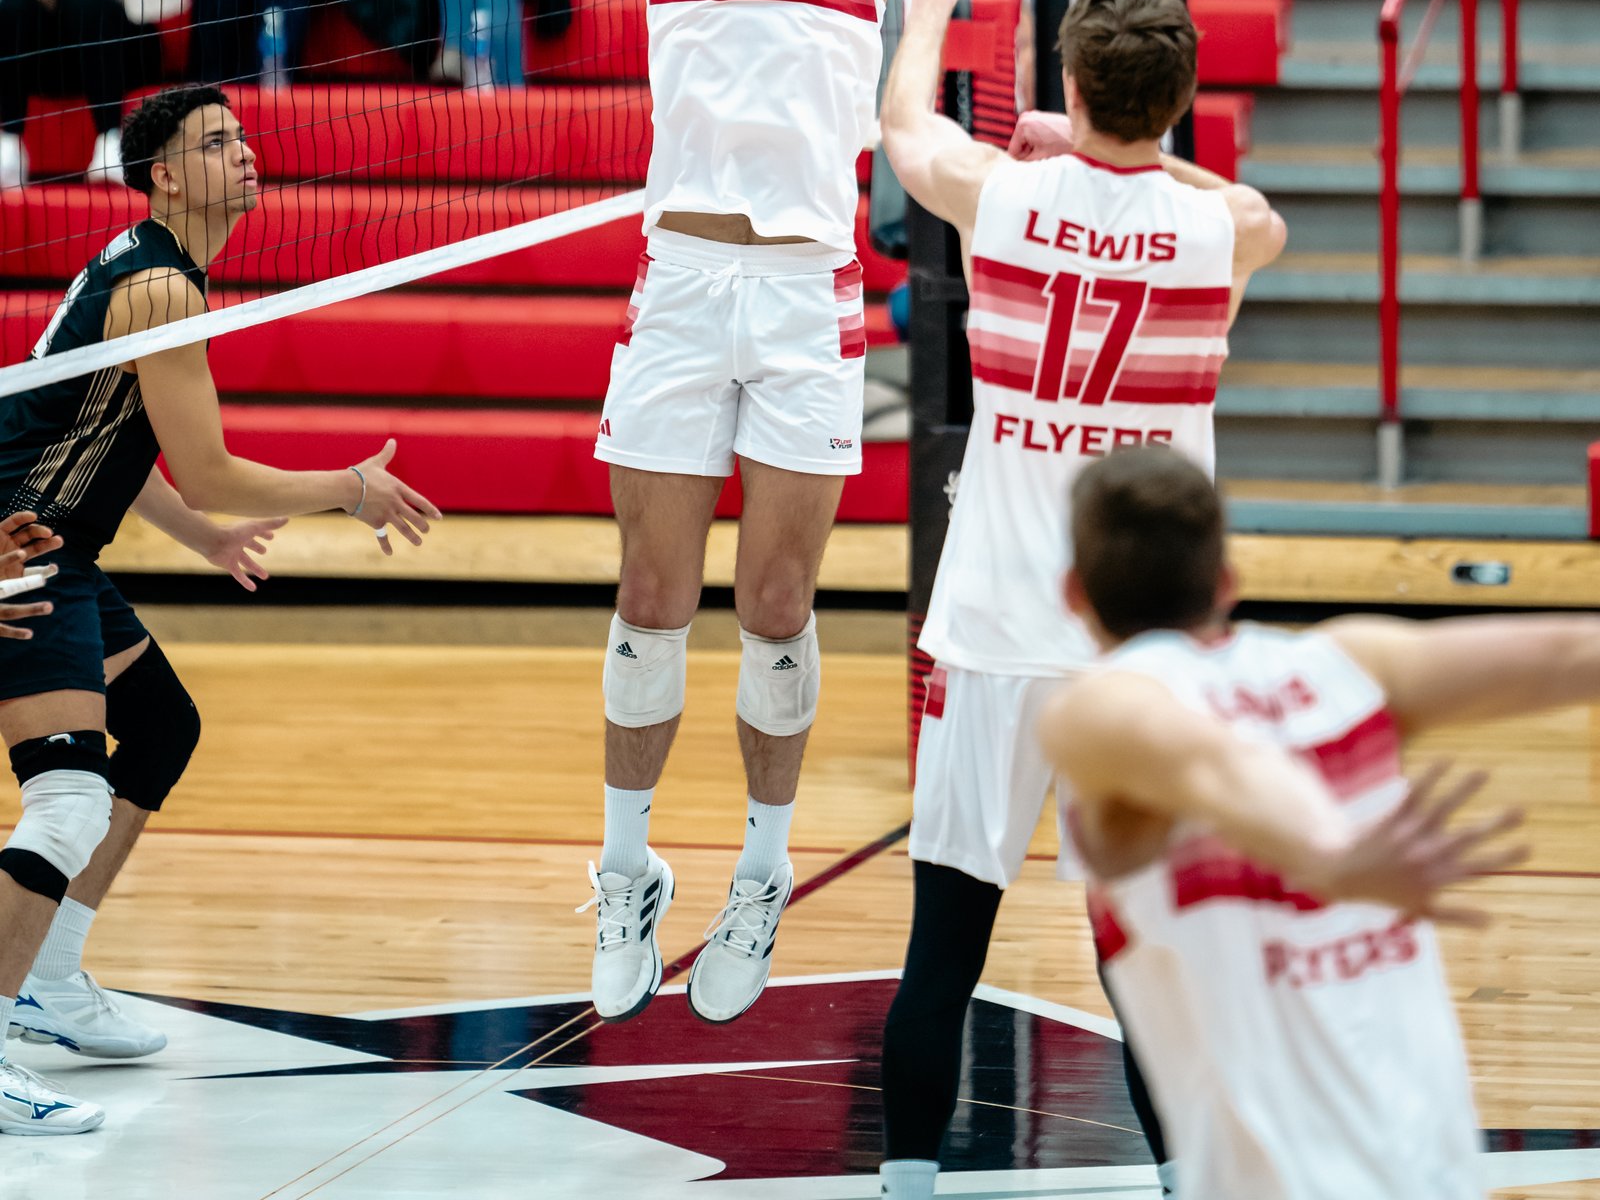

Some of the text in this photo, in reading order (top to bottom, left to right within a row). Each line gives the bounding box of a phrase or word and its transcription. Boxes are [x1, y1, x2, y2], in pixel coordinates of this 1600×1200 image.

[1023, 208, 1178, 263] LEWIS
[1032, 270, 1149, 408] 17
[615, 647, 638, 660] adidas
[771, 663, 798, 671] adidas
